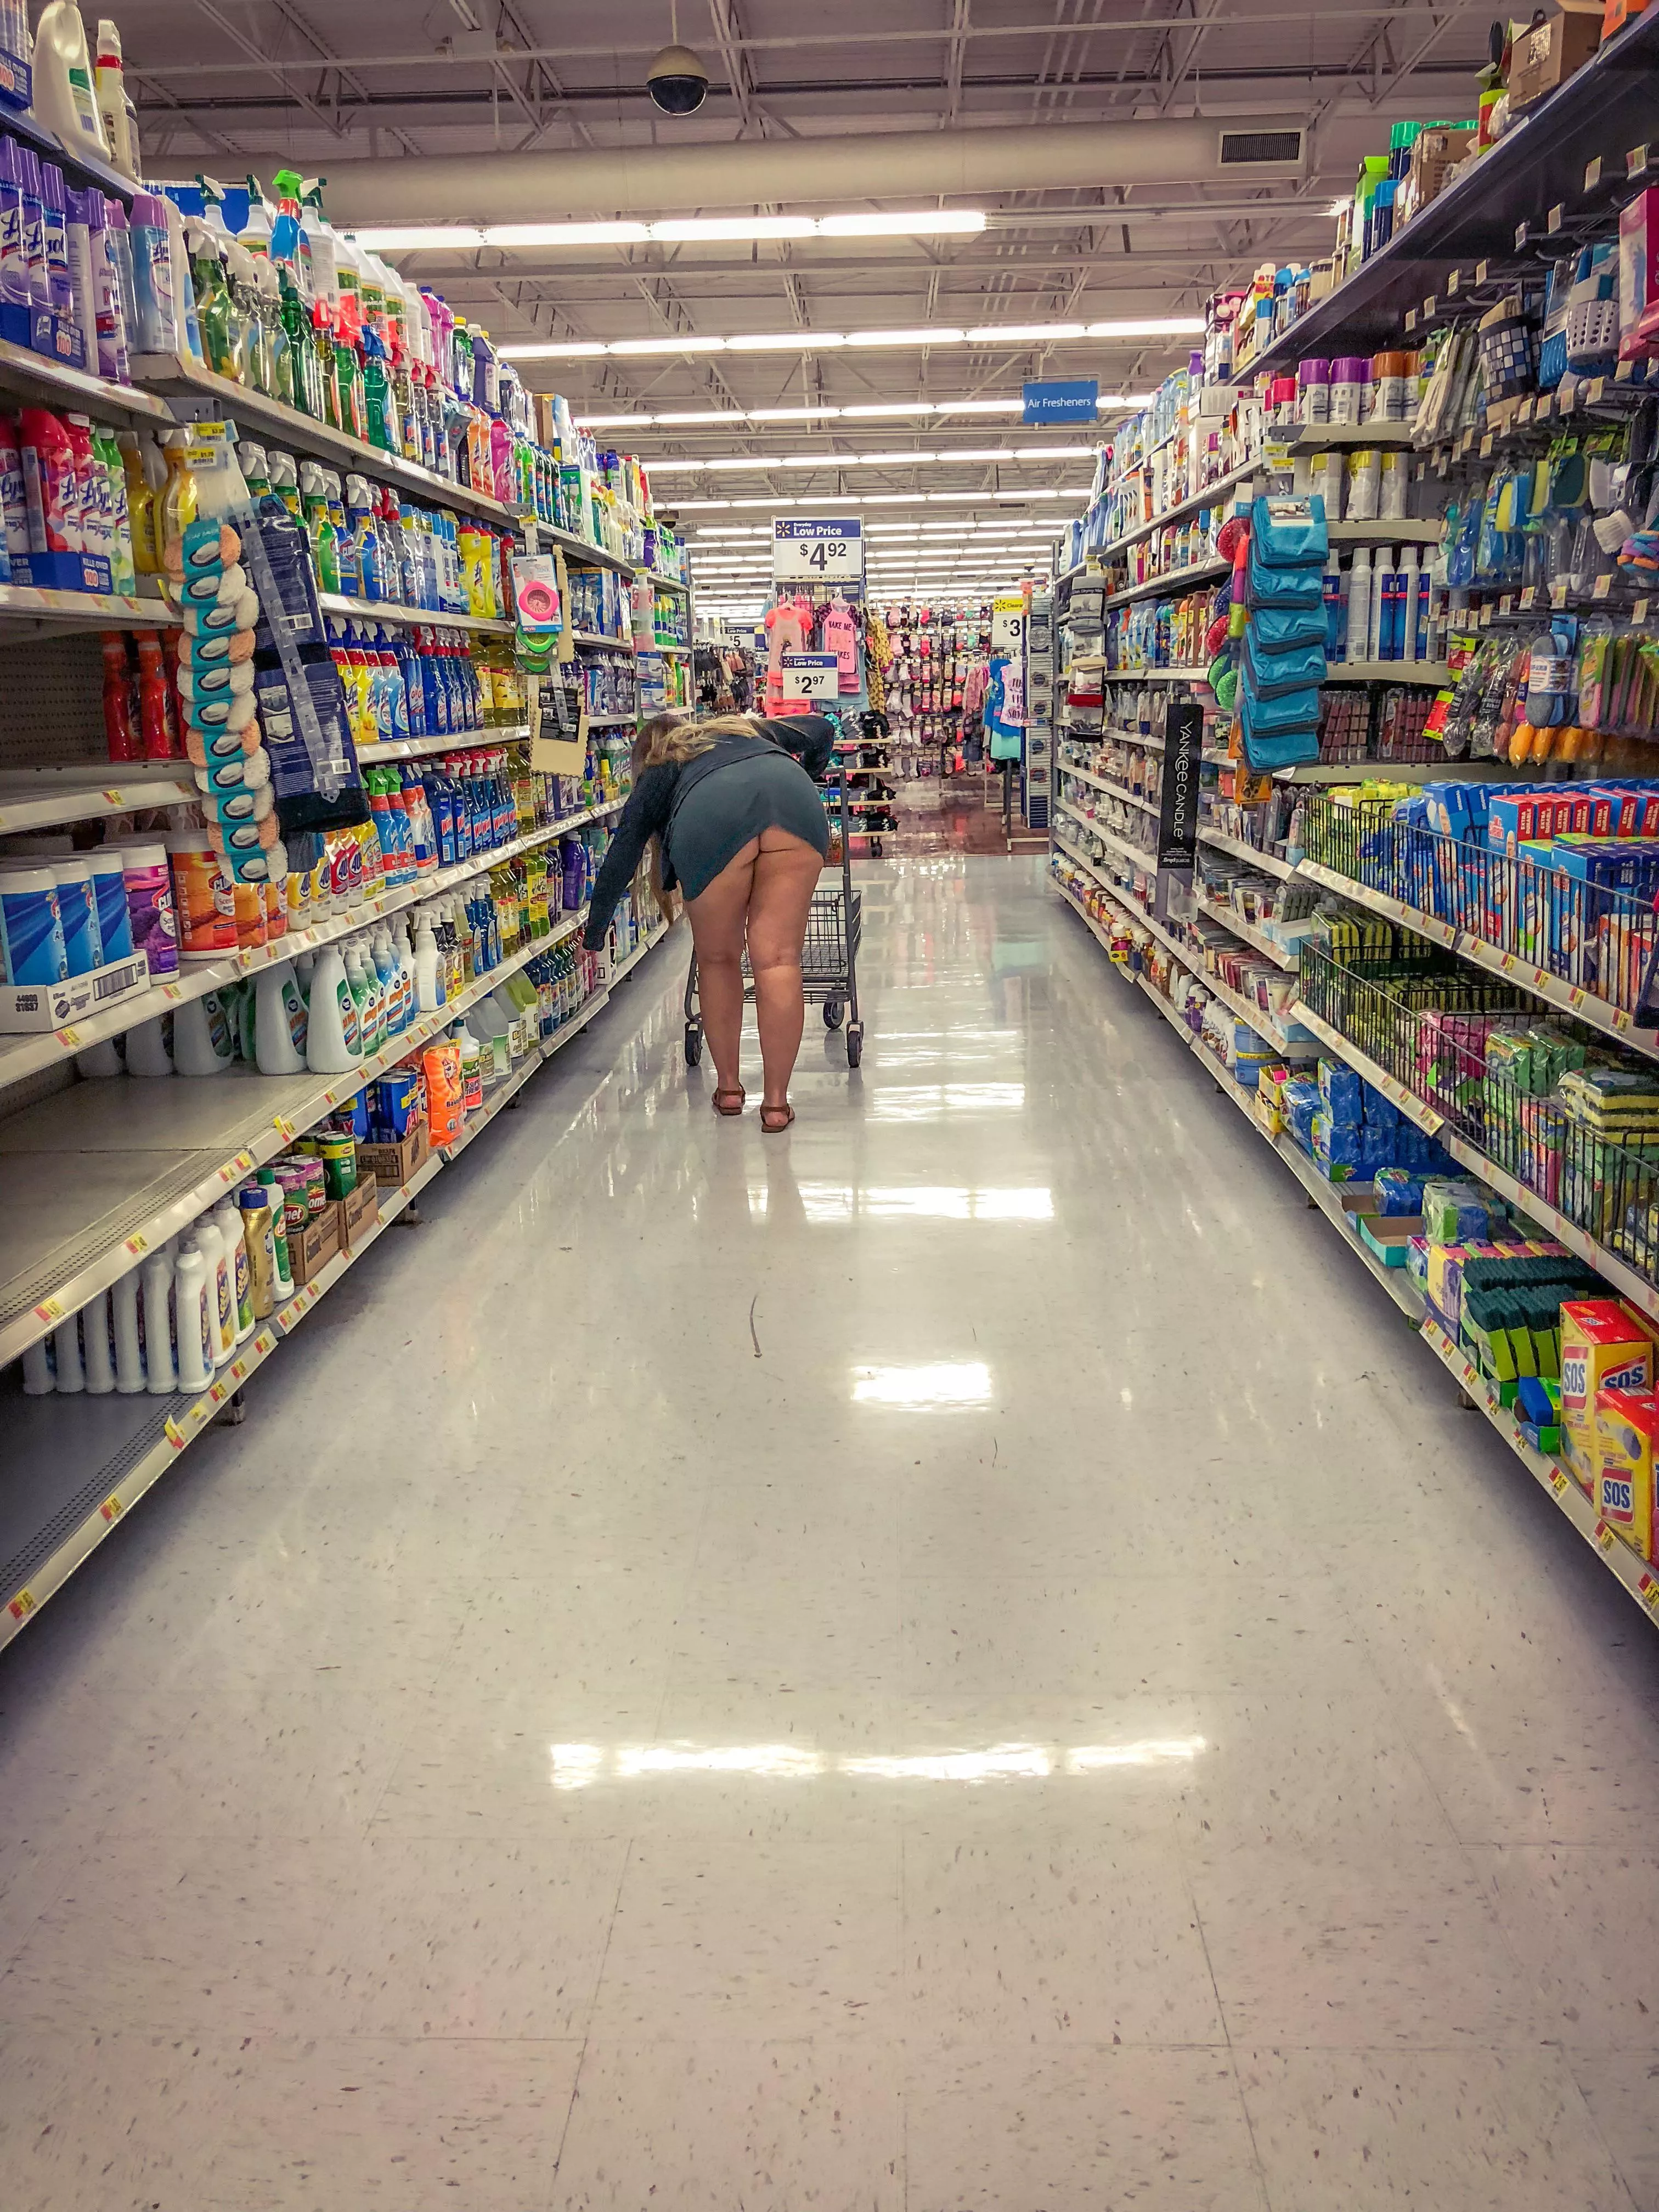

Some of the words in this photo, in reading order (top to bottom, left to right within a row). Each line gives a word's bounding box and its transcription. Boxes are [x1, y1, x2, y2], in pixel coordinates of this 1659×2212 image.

[57, 330, 71, 356] 100
[1028, 399, 1041, 408] Air
[1043, 397, 1091, 408] Fresheners
[793, 527, 815, 536] Low
[816, 526, 842, 536] Price
[84, 568, 99, 588] 100
[1002, 619, 1020, 637] $3
[729, 635, 741, 647] $5
[1627, 802, 1635, 829] DURABLE
[1604, 1365, 1644, 1389] SOS
[1603, 1479, 1631, 1510] SOS
